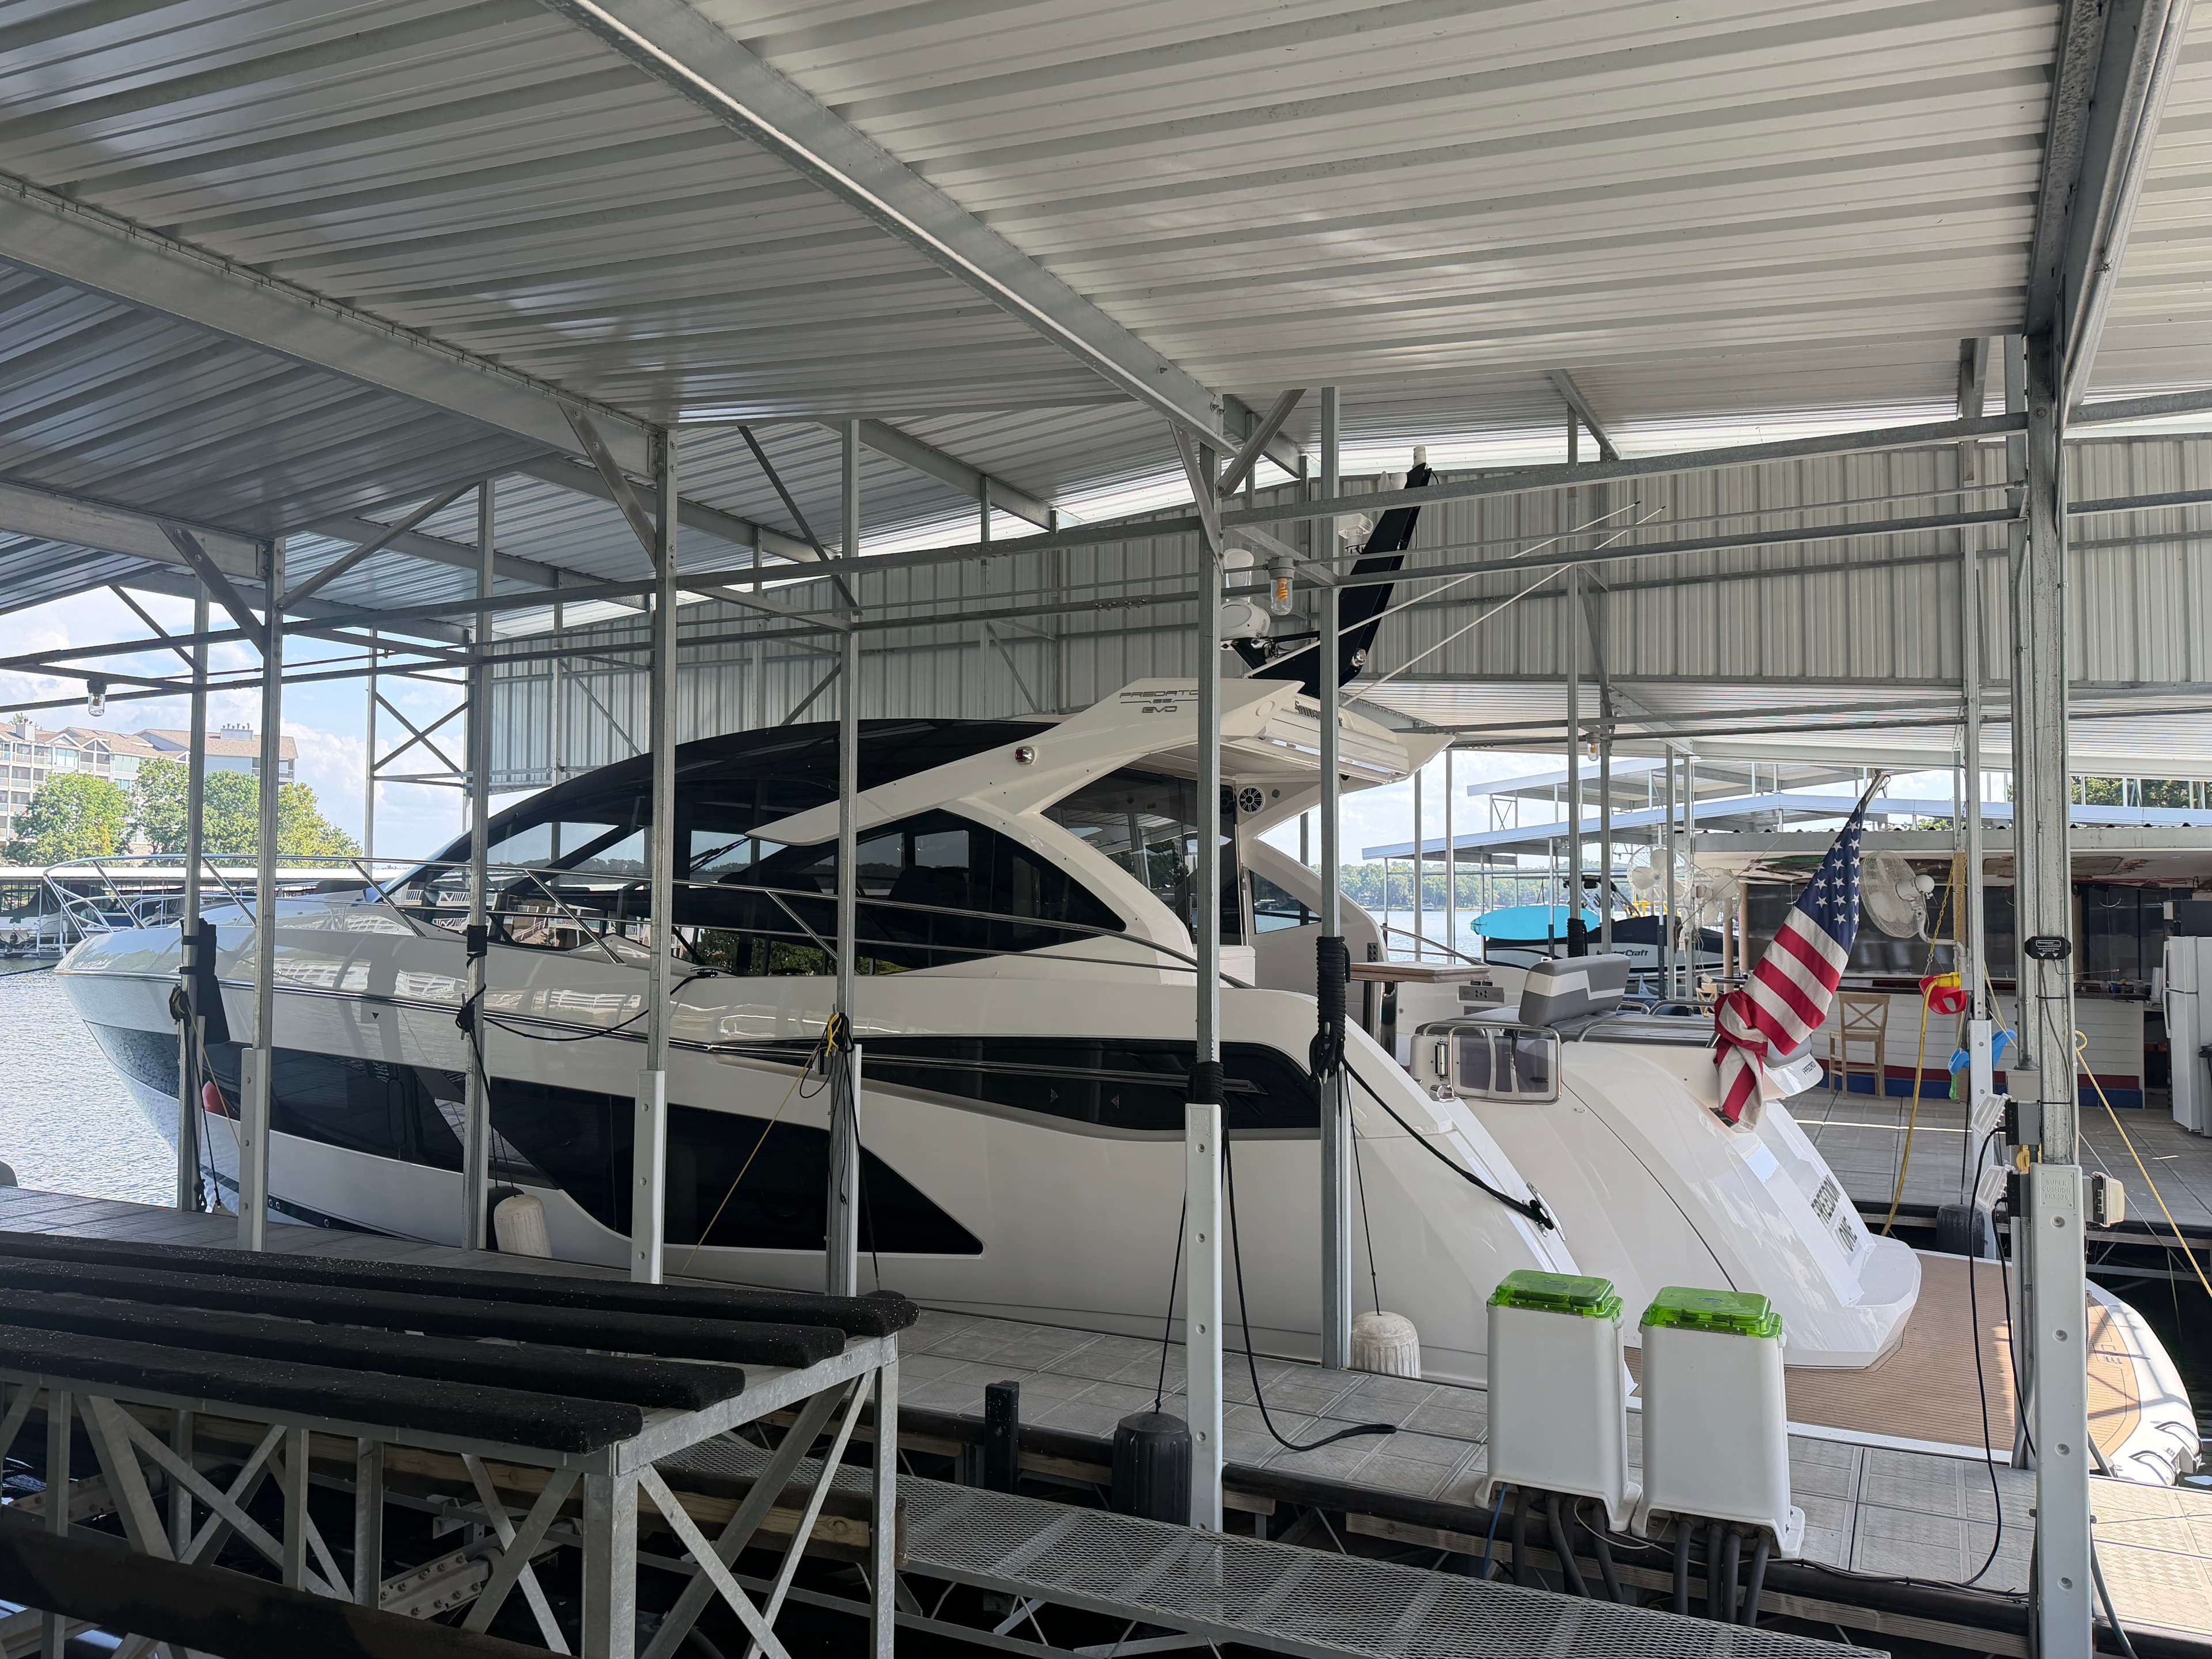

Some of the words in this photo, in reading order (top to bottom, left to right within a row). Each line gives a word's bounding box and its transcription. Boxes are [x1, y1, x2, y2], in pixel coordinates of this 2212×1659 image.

[1120, 690, 1198, 698] PREDATO
[1810, 1174, 1841, 1229] FREEDOM
[1839, 1216, 1858, 1252] ONE
